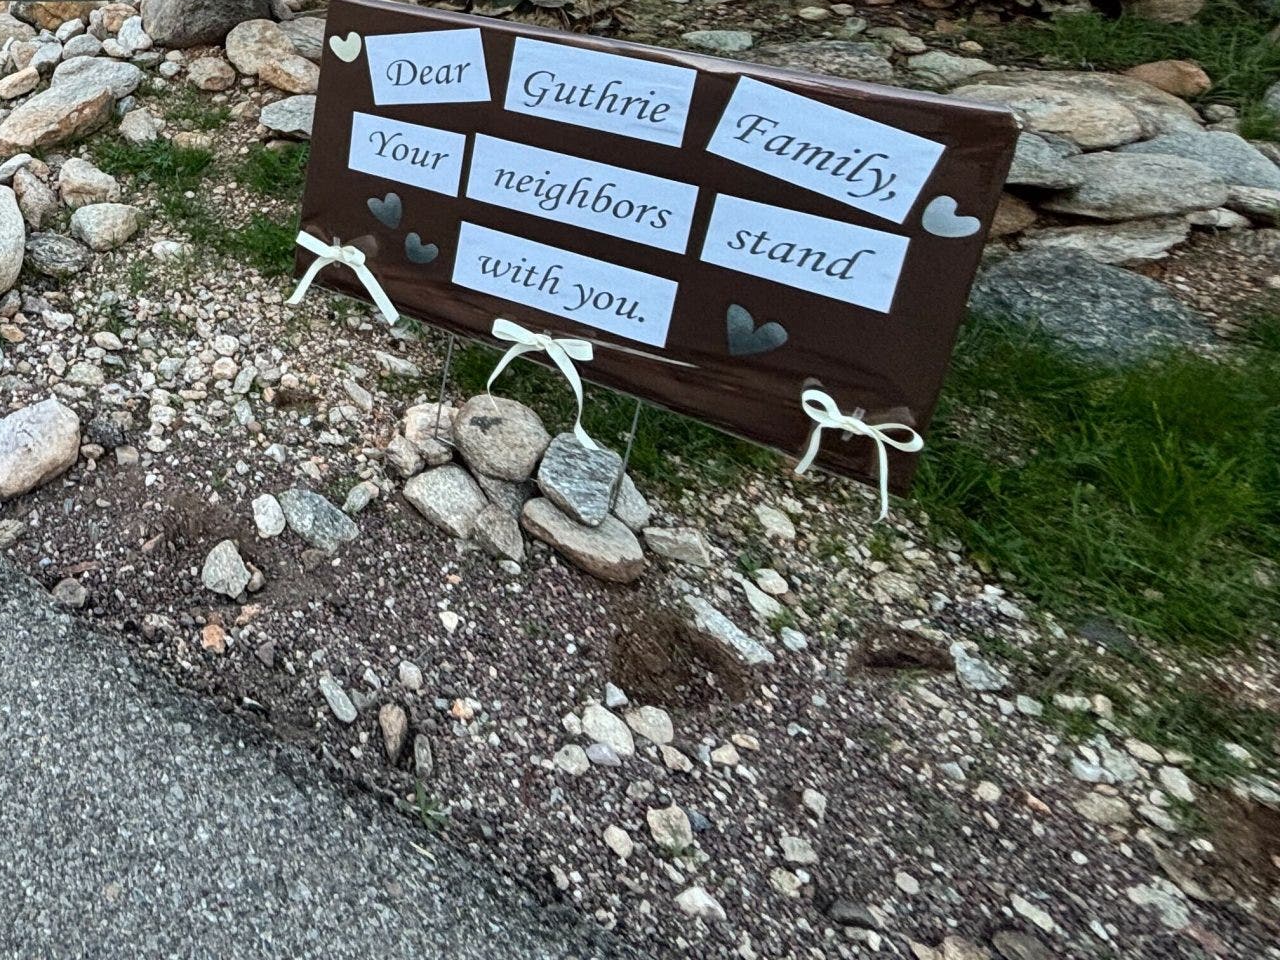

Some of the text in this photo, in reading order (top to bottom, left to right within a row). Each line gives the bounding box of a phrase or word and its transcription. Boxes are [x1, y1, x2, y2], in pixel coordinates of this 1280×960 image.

[386, 59, 897, 202] Dear Guthrie Family,
[369, 131, 876, 280] Your neighbors stand
[478, 255, 645, 323] with you.
